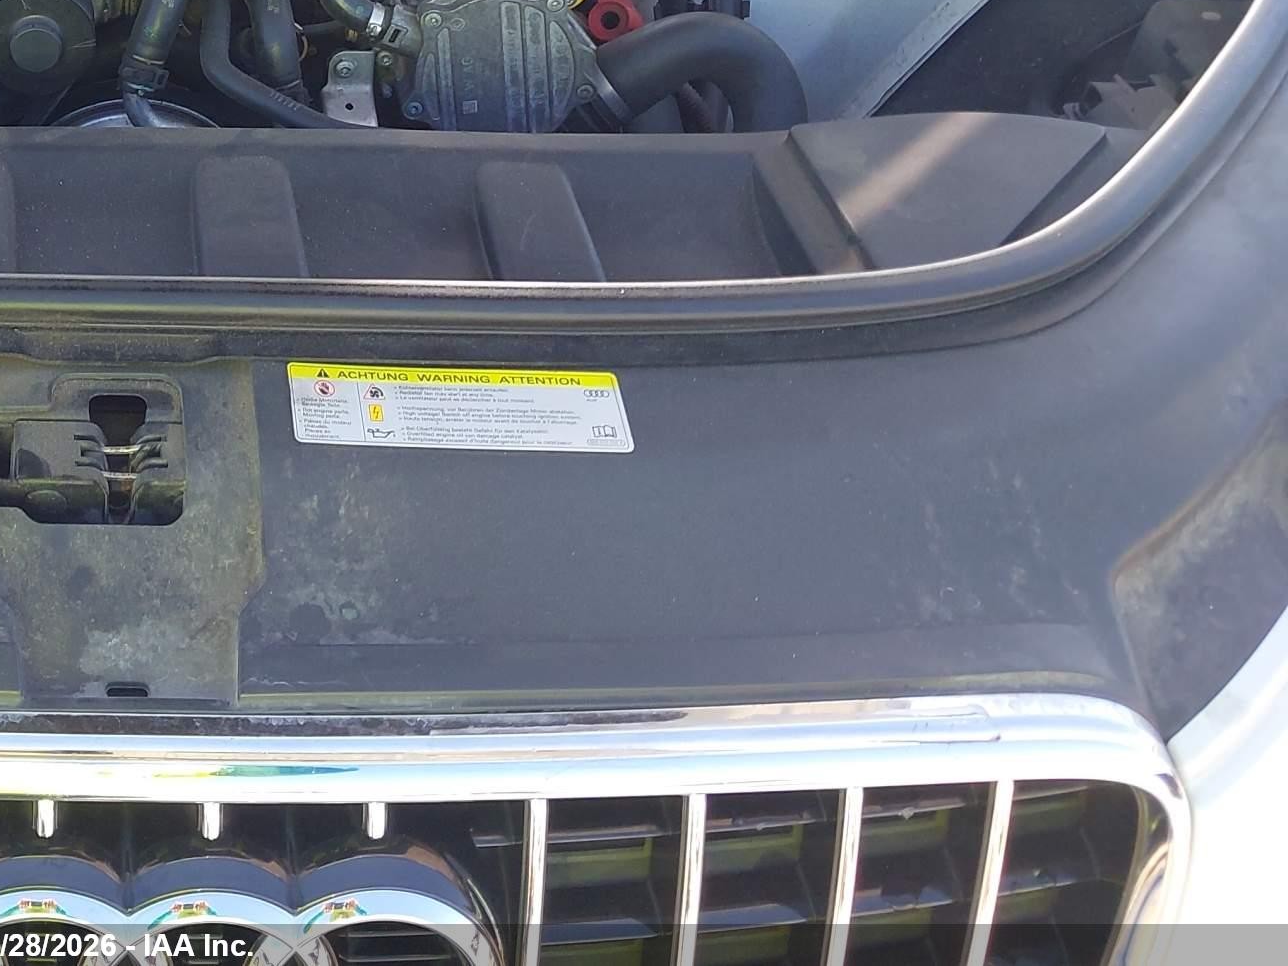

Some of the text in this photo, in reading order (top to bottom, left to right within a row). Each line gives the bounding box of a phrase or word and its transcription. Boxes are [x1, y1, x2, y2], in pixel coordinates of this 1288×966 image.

[337, 370, 581, 386] ACHTUNG WARNING ATTENTION
